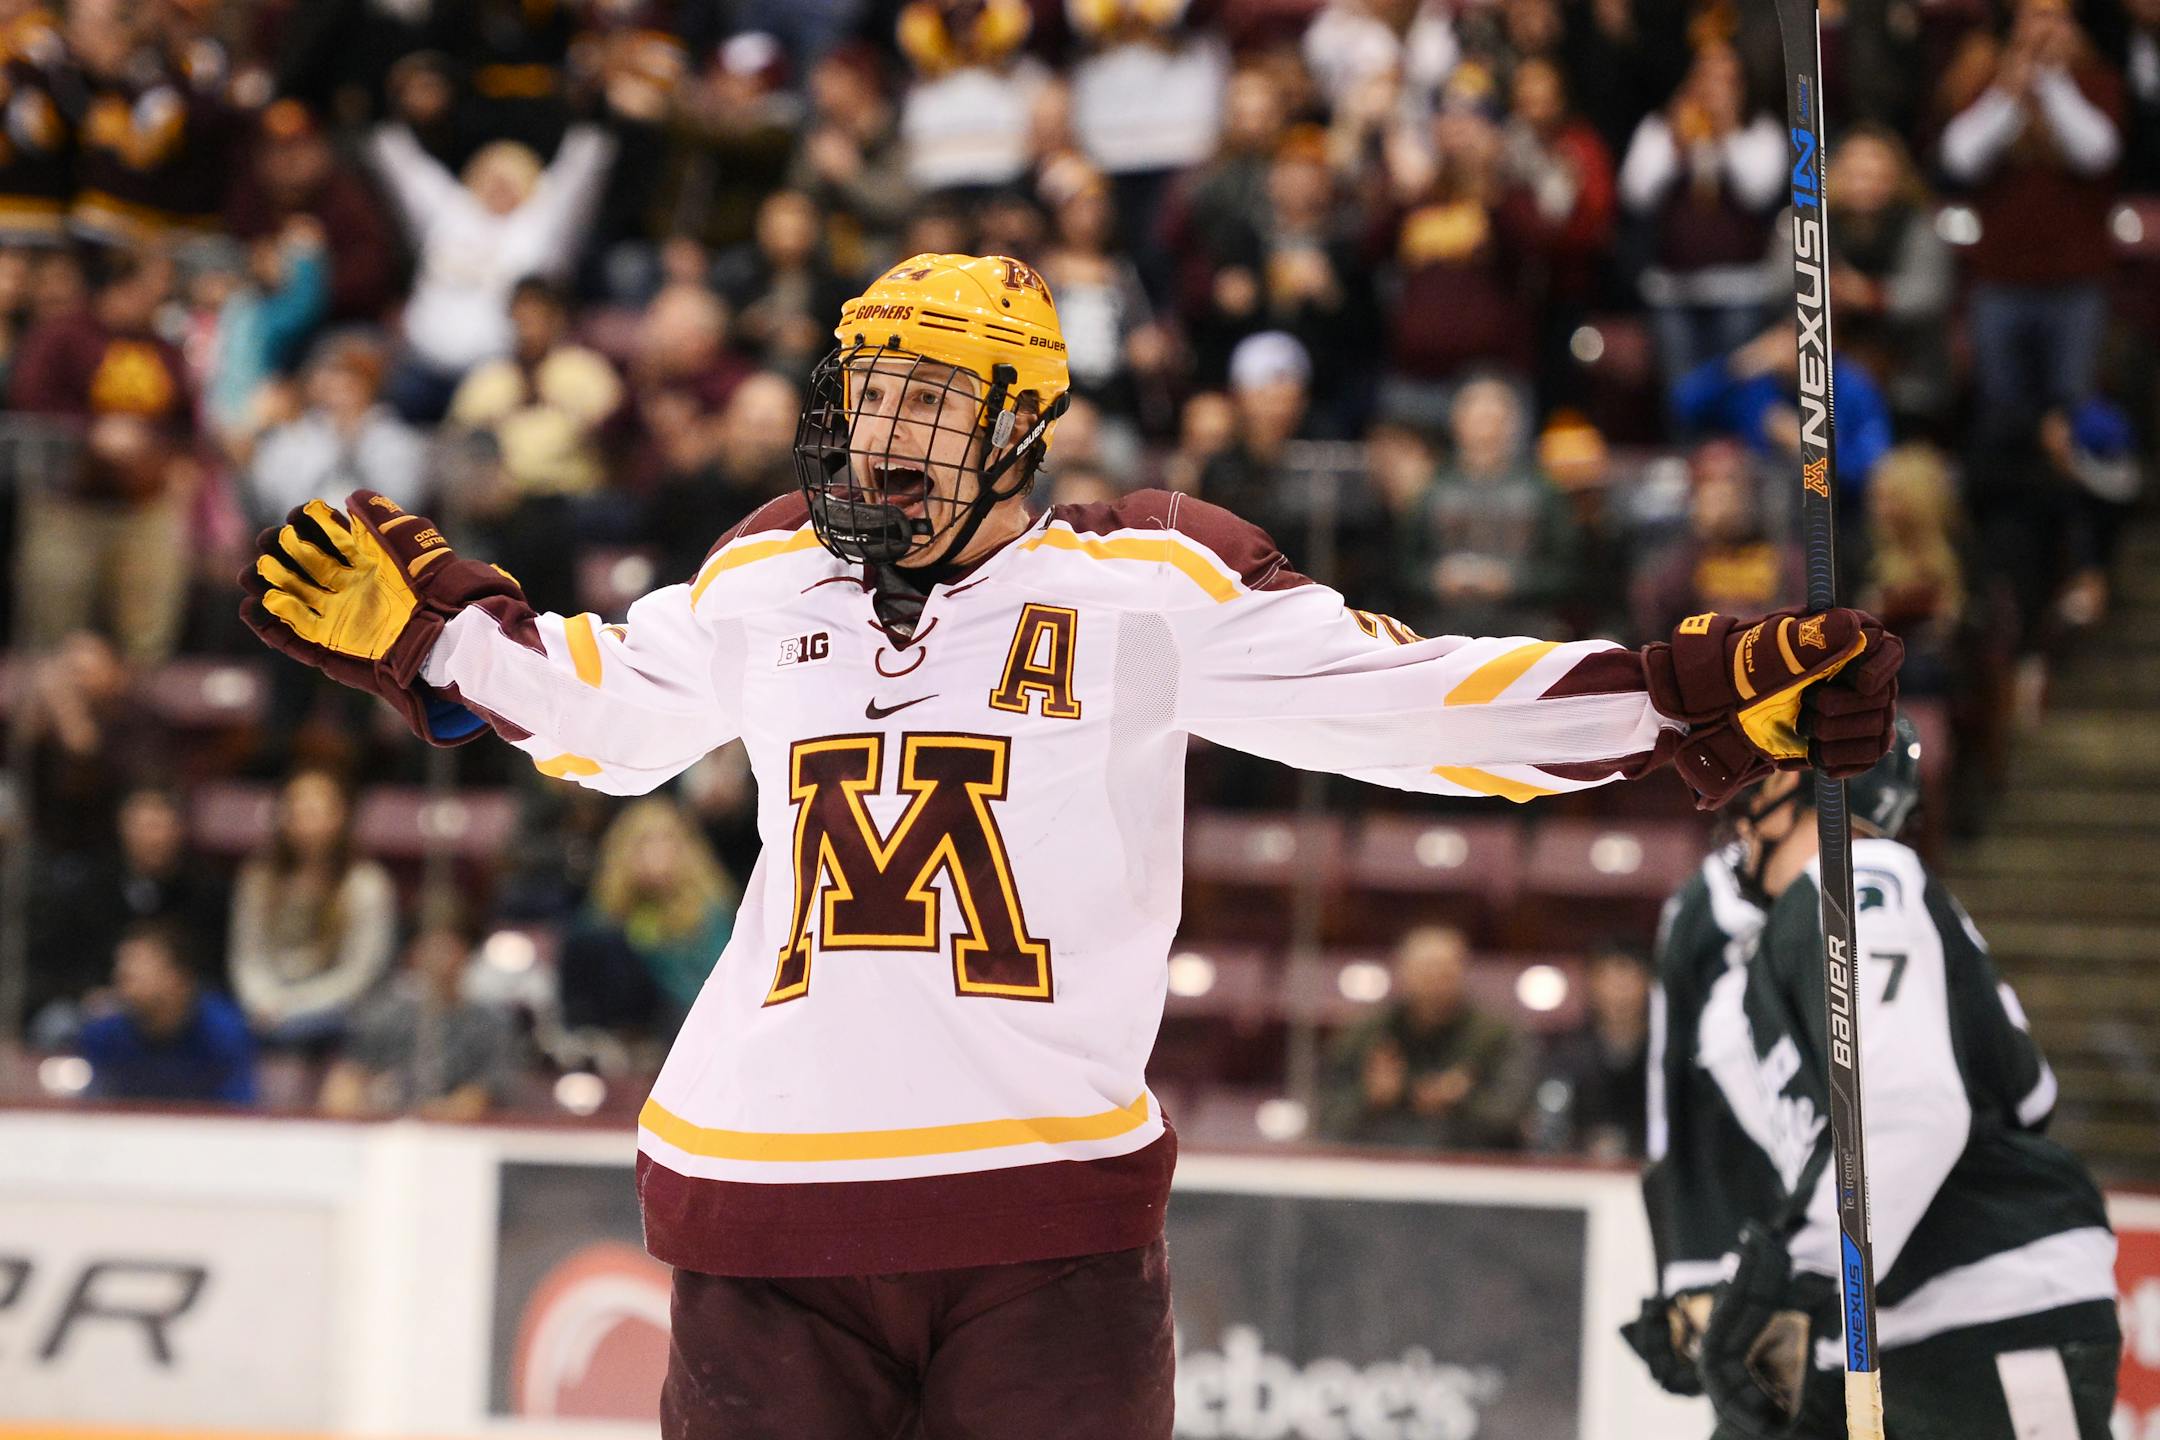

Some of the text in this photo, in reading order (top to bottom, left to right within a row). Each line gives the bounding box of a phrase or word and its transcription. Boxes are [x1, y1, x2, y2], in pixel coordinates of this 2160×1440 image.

[855, 305, 914, 321] GOPHERS
[1793, 216, 1829, 449] NEXUS
[988, 602, 1081, 720] A
[761, 731, 1054, 1008] M
[1828, 934, 1852, 1070] BAUER
[1869, 952, 1908, 1004] 7
[1849, 1263, 1863, 1353] NEXUS
